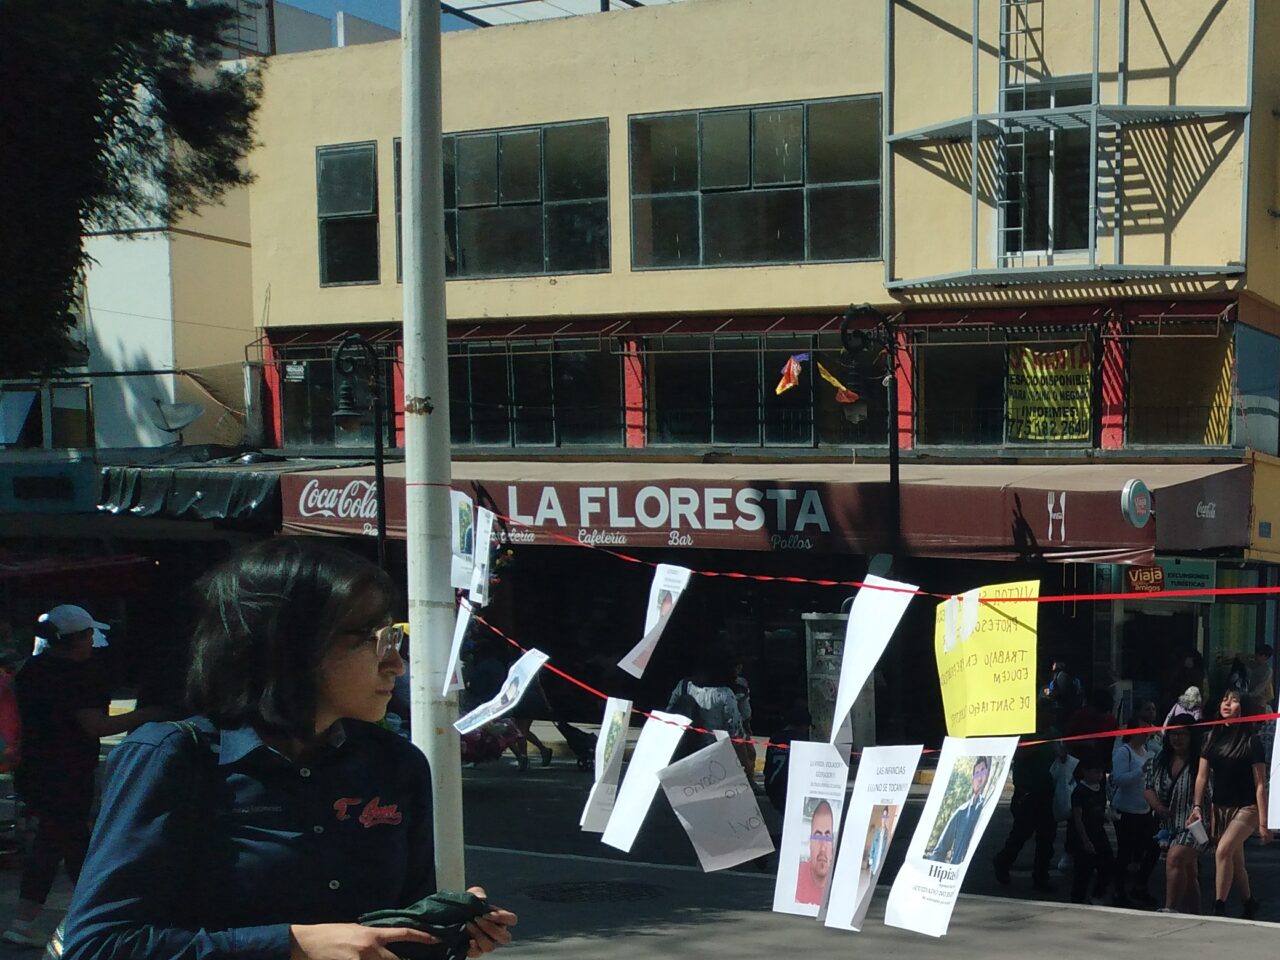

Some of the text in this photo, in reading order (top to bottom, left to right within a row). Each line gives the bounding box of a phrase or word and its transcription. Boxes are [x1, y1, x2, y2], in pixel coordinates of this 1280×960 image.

[508, 485, 831, 533] LA FLORESTA
[668, 530, 694, 547] Bar
[770, 533, 814, 551] Pollos
[1129, 567, 1163, 584] Viaja
